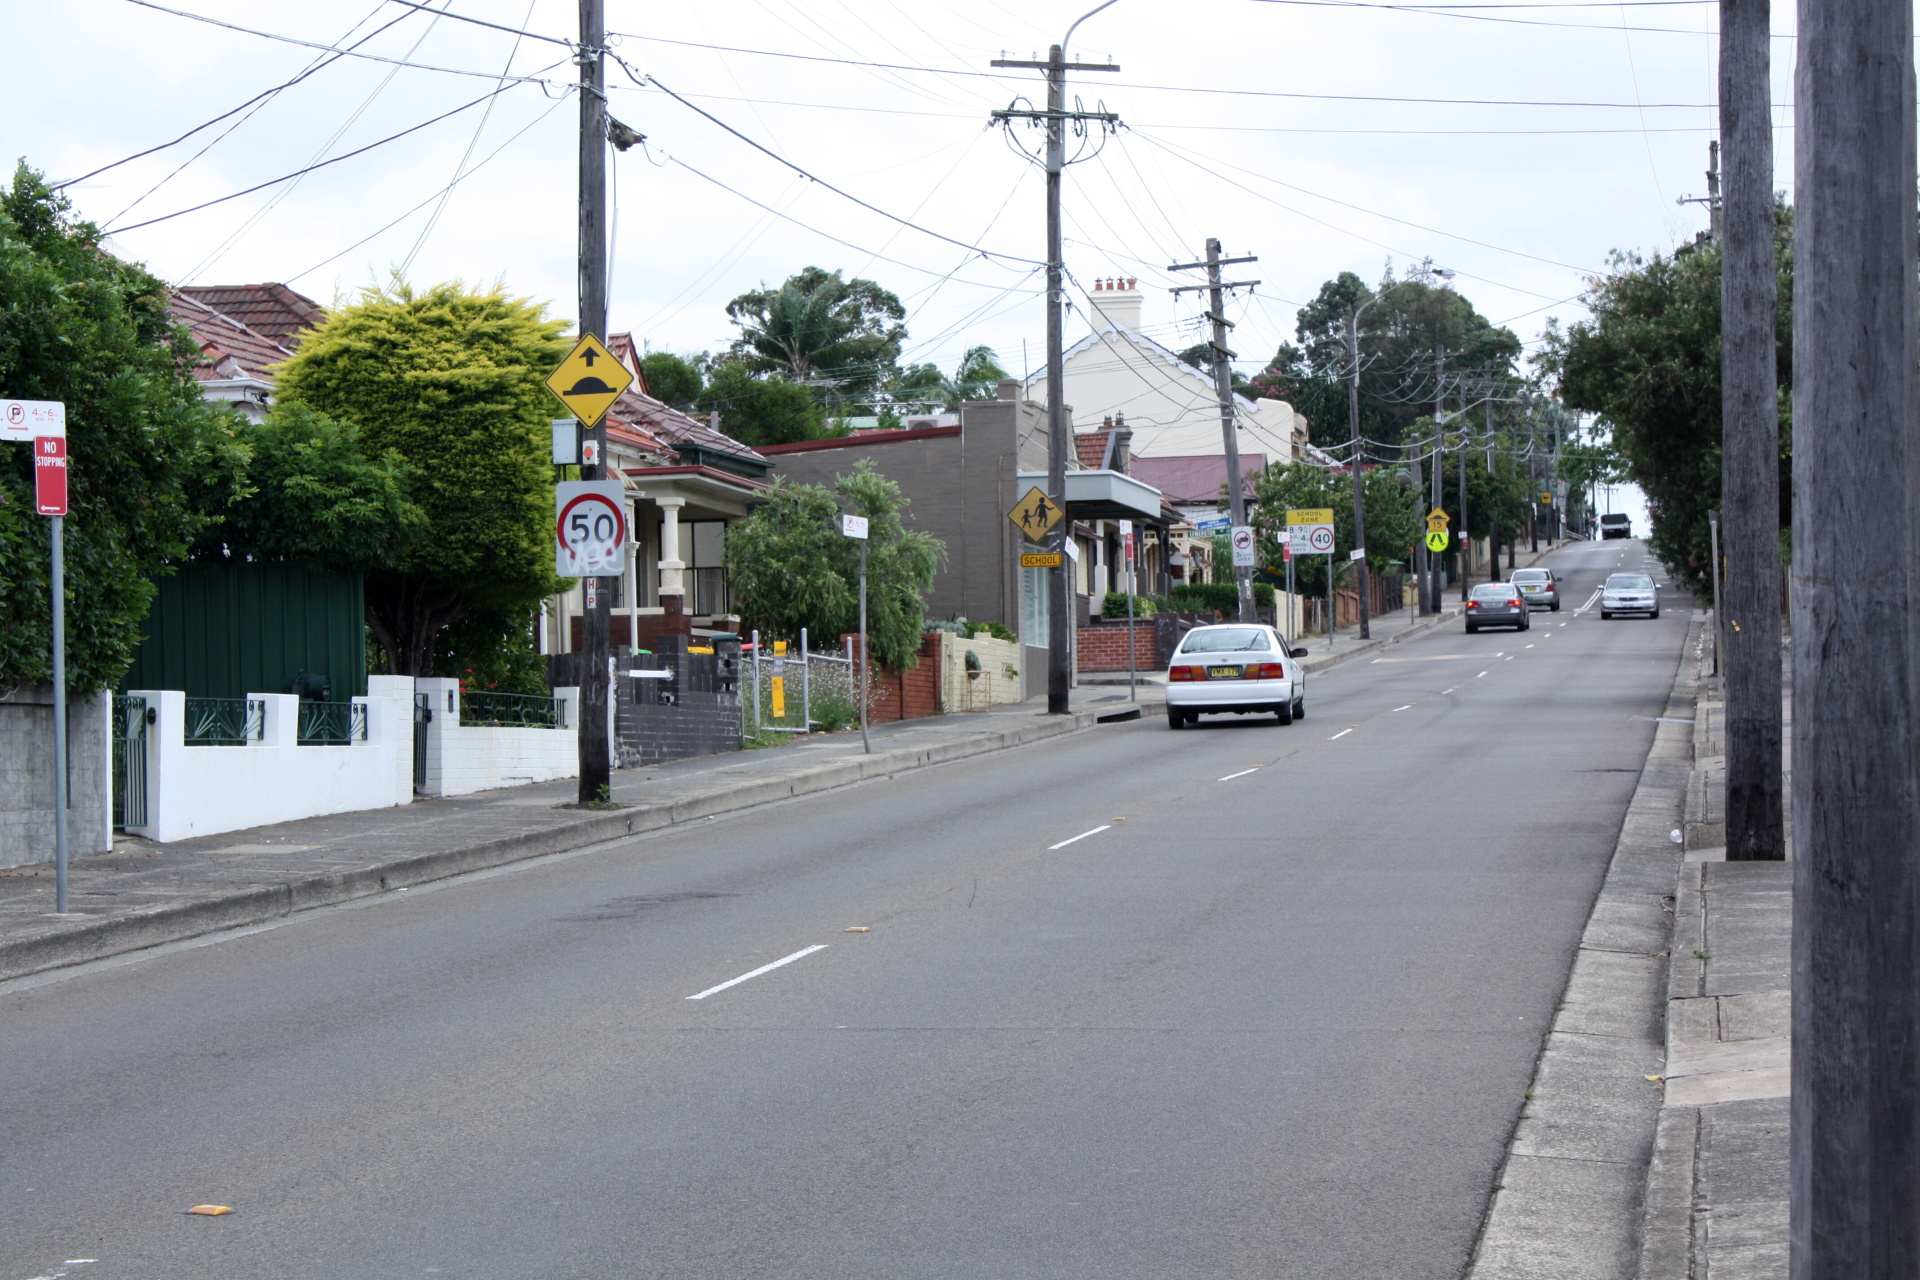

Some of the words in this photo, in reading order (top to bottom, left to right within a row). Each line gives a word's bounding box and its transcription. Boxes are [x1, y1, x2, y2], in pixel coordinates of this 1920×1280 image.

[44, 441, 56, 453] NO
[36, 456, 65, 467] STOPPING
[571, 514, 614, 544] 50
[1315, 534, 1330, 544] 40
[1024, 556, 1057, 564] SCHOOL
